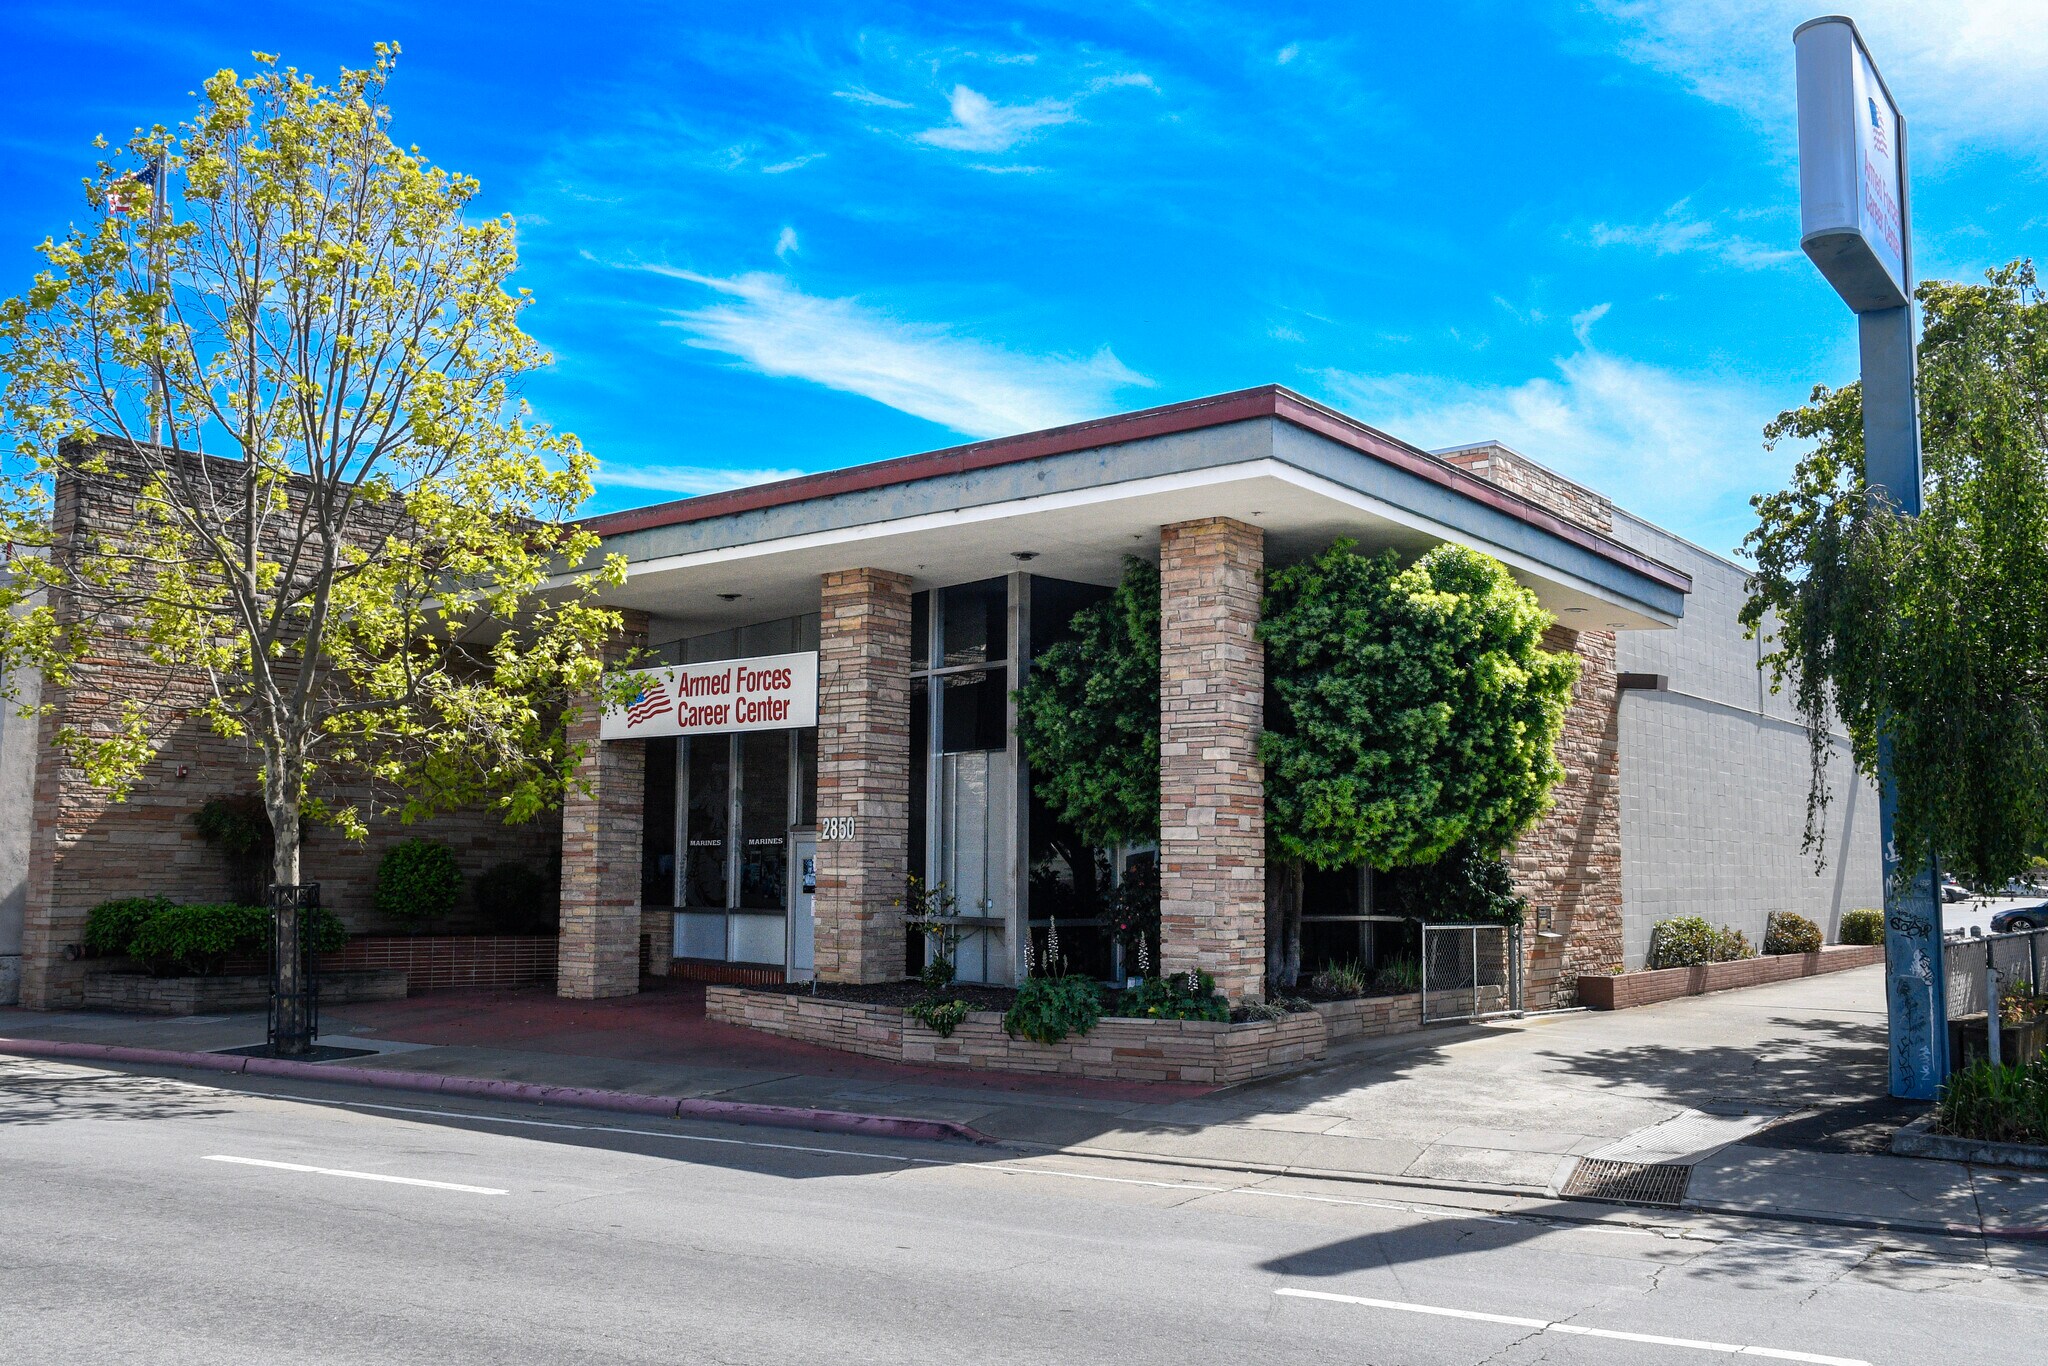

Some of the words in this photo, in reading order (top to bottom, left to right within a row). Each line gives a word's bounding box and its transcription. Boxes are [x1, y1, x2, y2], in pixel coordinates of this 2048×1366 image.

[678, 668, 731, 697] Armed
[737, 667, 791, 693] Forces
[677, 701, 730, 727] Career
[735, 696, 790, 723] Center
[748, 837, 783, 846] MARINES
[822, 816, 855, 840] 2850
